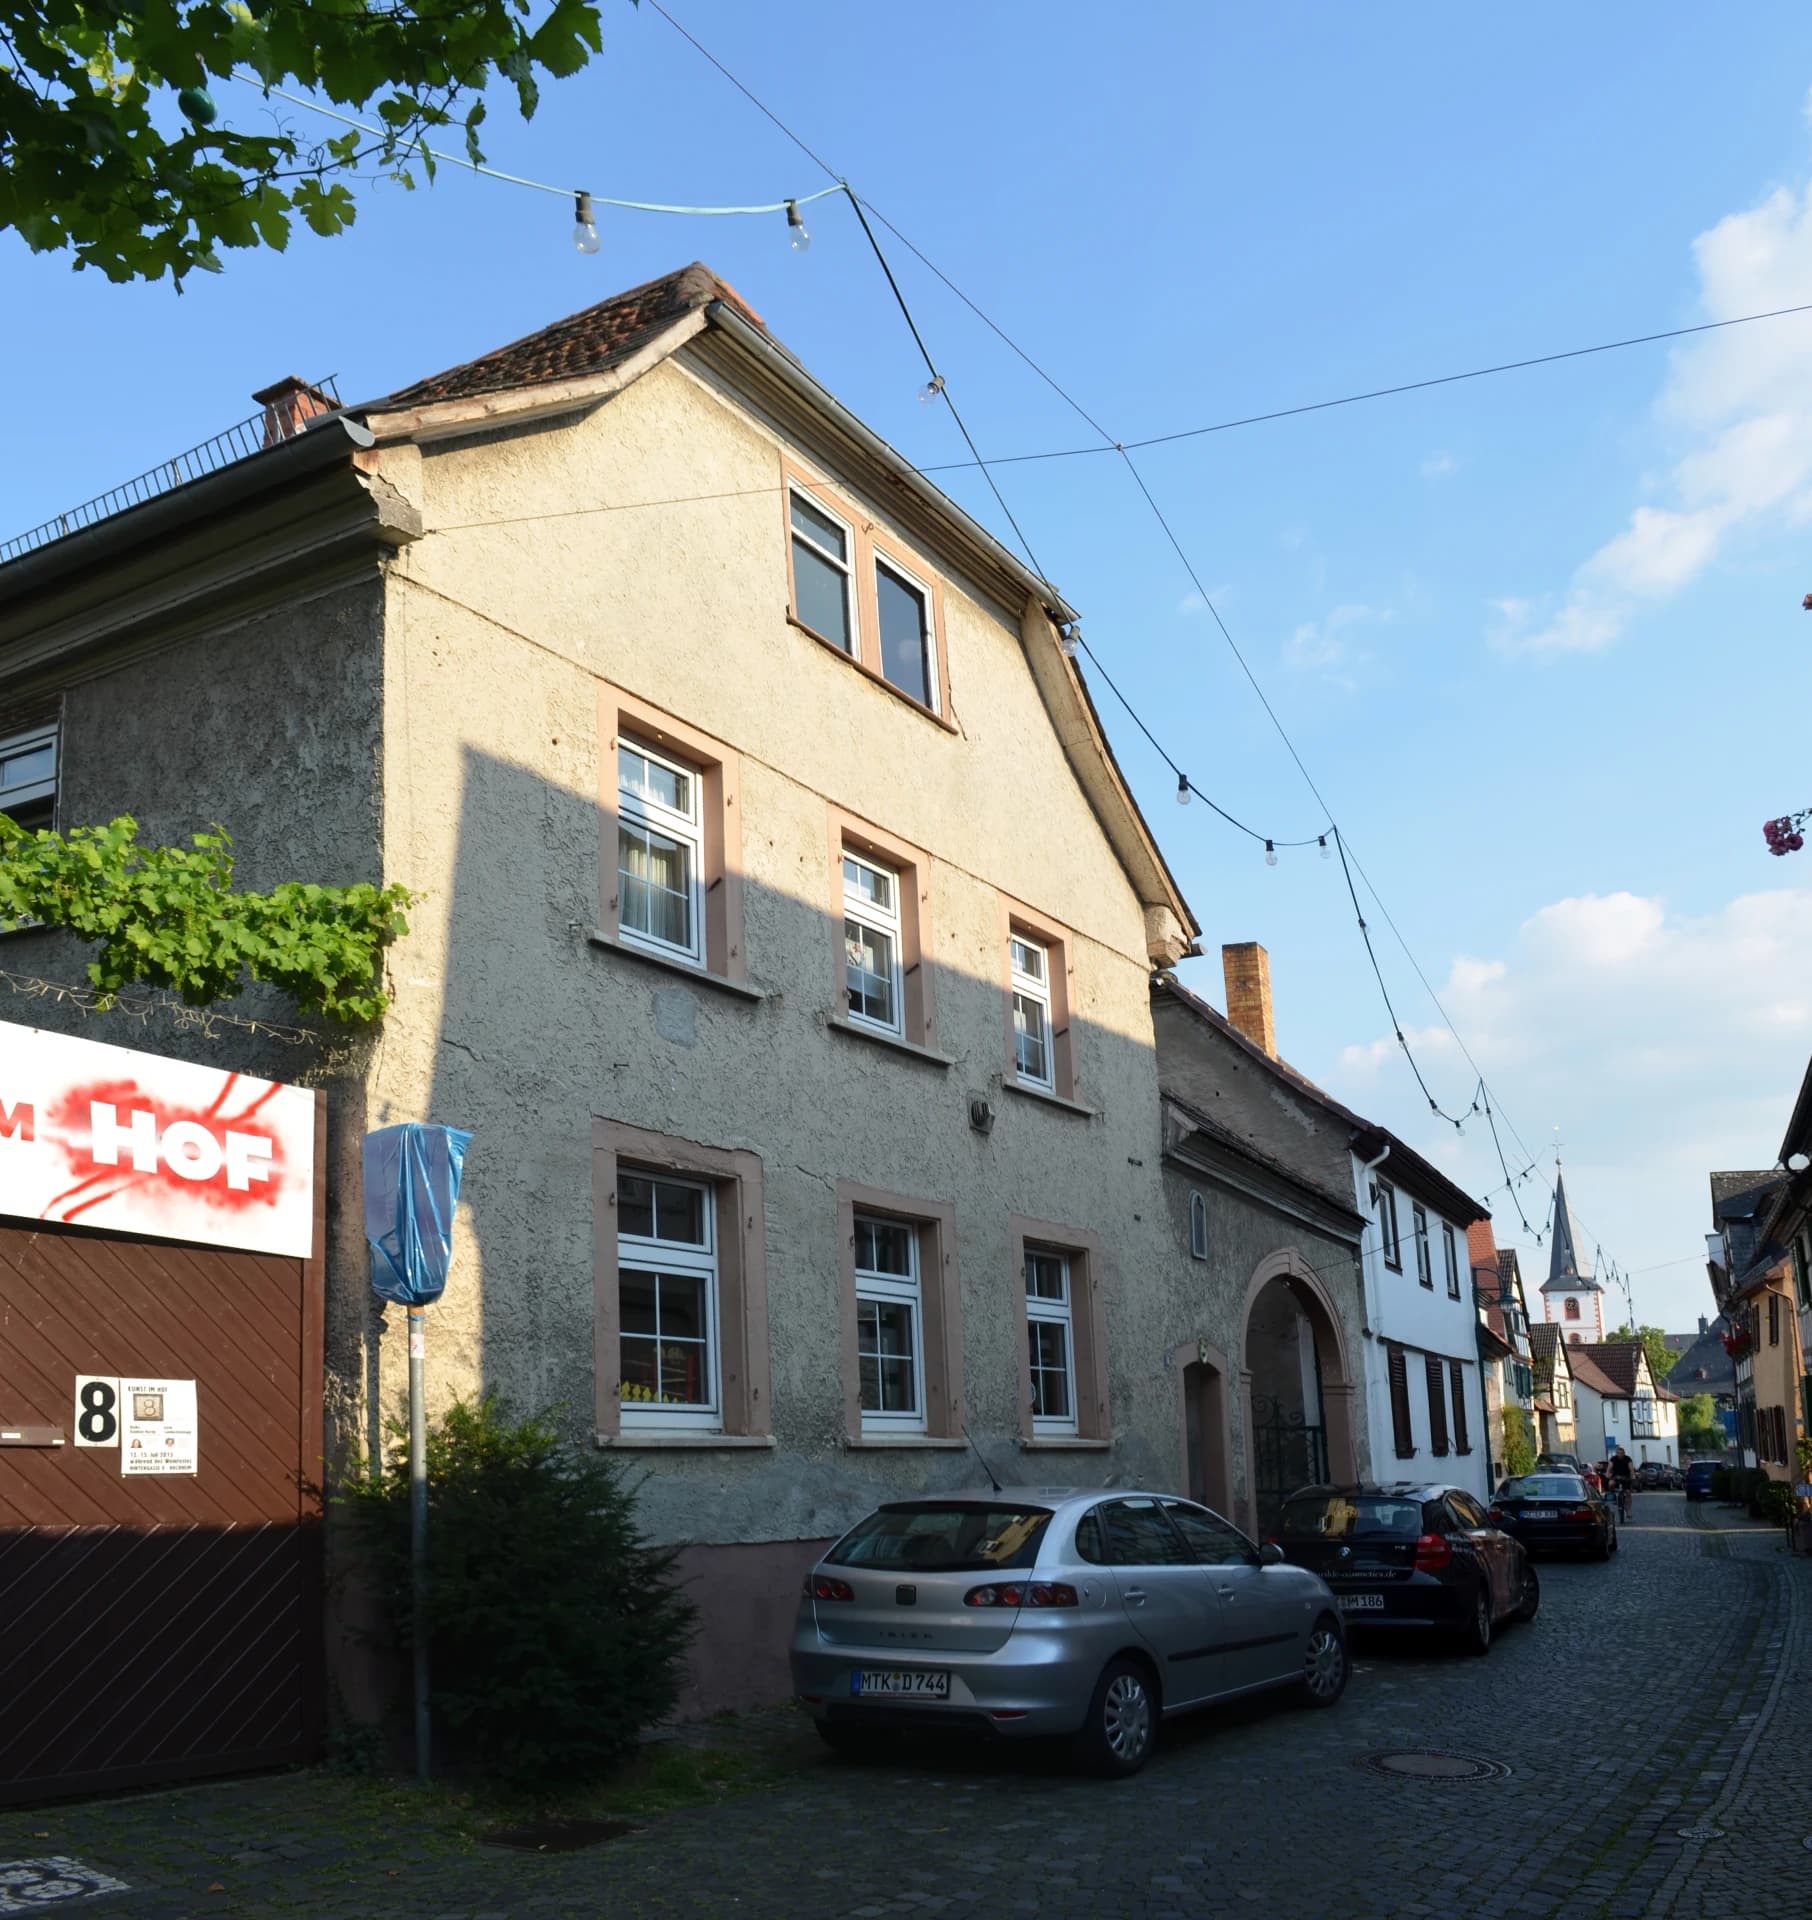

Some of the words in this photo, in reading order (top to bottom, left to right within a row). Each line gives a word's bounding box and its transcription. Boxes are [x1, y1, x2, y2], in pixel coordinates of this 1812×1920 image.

[90, 1100, 272, 1191] HOF
[79, 1381, 117, 1442] 8
[144, 1399, 156, 1416] 8
[1361, 1595, 1383, 1608] 186
[861, 1673, 892, 1690] MTK
